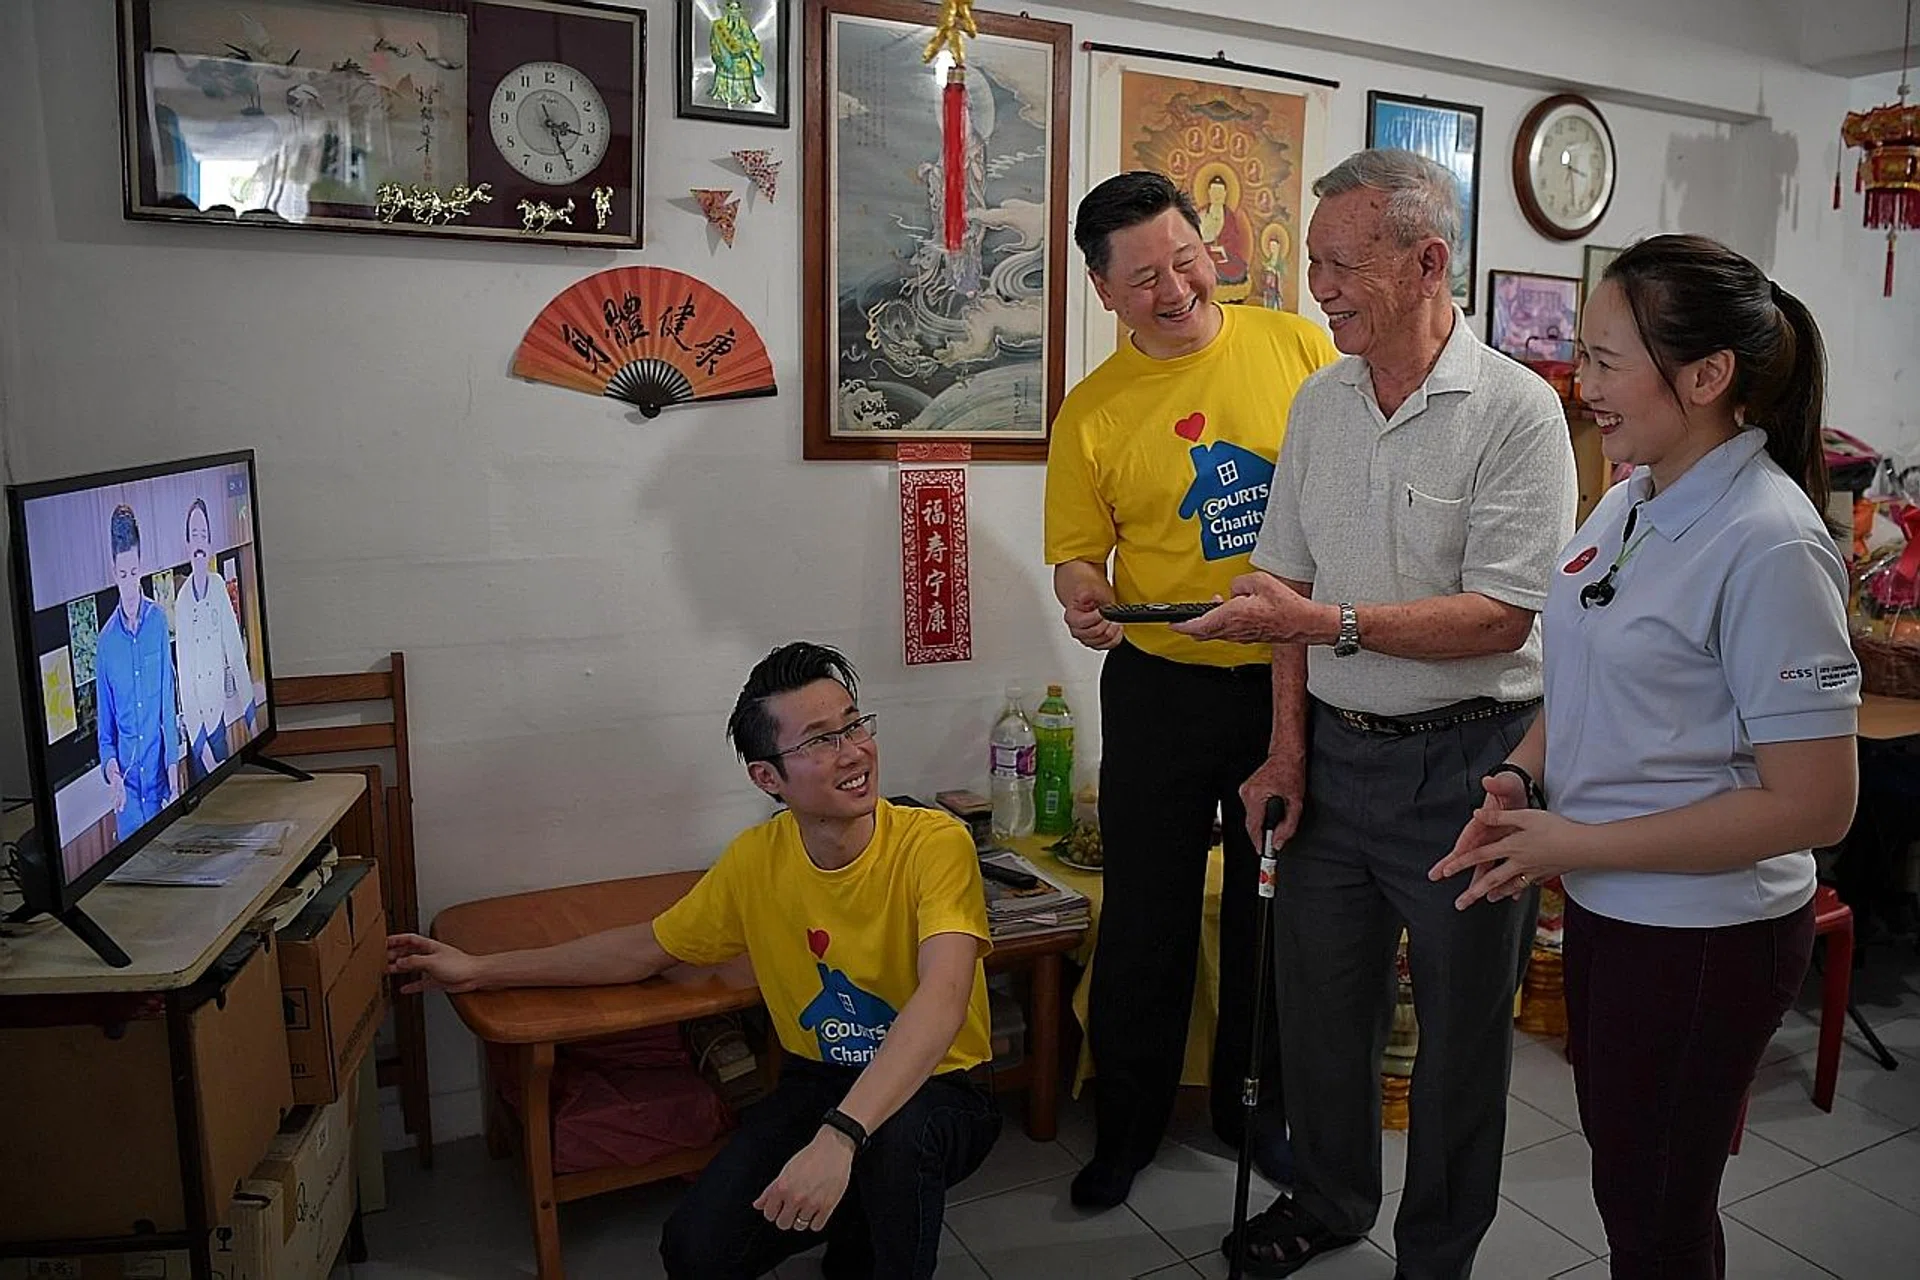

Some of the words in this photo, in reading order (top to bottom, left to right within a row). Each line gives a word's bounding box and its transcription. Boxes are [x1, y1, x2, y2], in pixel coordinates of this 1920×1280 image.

[521, 75, 529, 88] 11
[544, 72, 555, 83] 12
[569, 80, 573, 92] 1
[505, 90, 516, 102] 10
[582, 100, 591, 112] 2
[500, 112, 509, 124] 9
[587, 121, 596, 133] 3
[506, 135, 515, 148] 8
[581, 143, 590, 155] 4
[522, 154, 531, 166] 7
[544, 162, 553, 174] 6
[1203, 484, 1269, 519] COURTS
[1218, 531, 1257, 550] Hom
[920, 499, 948, 634] 福寿宁康
[1780, 669, 1812, 679] CCSS
[830, 1046, 877, 1062] Chari
